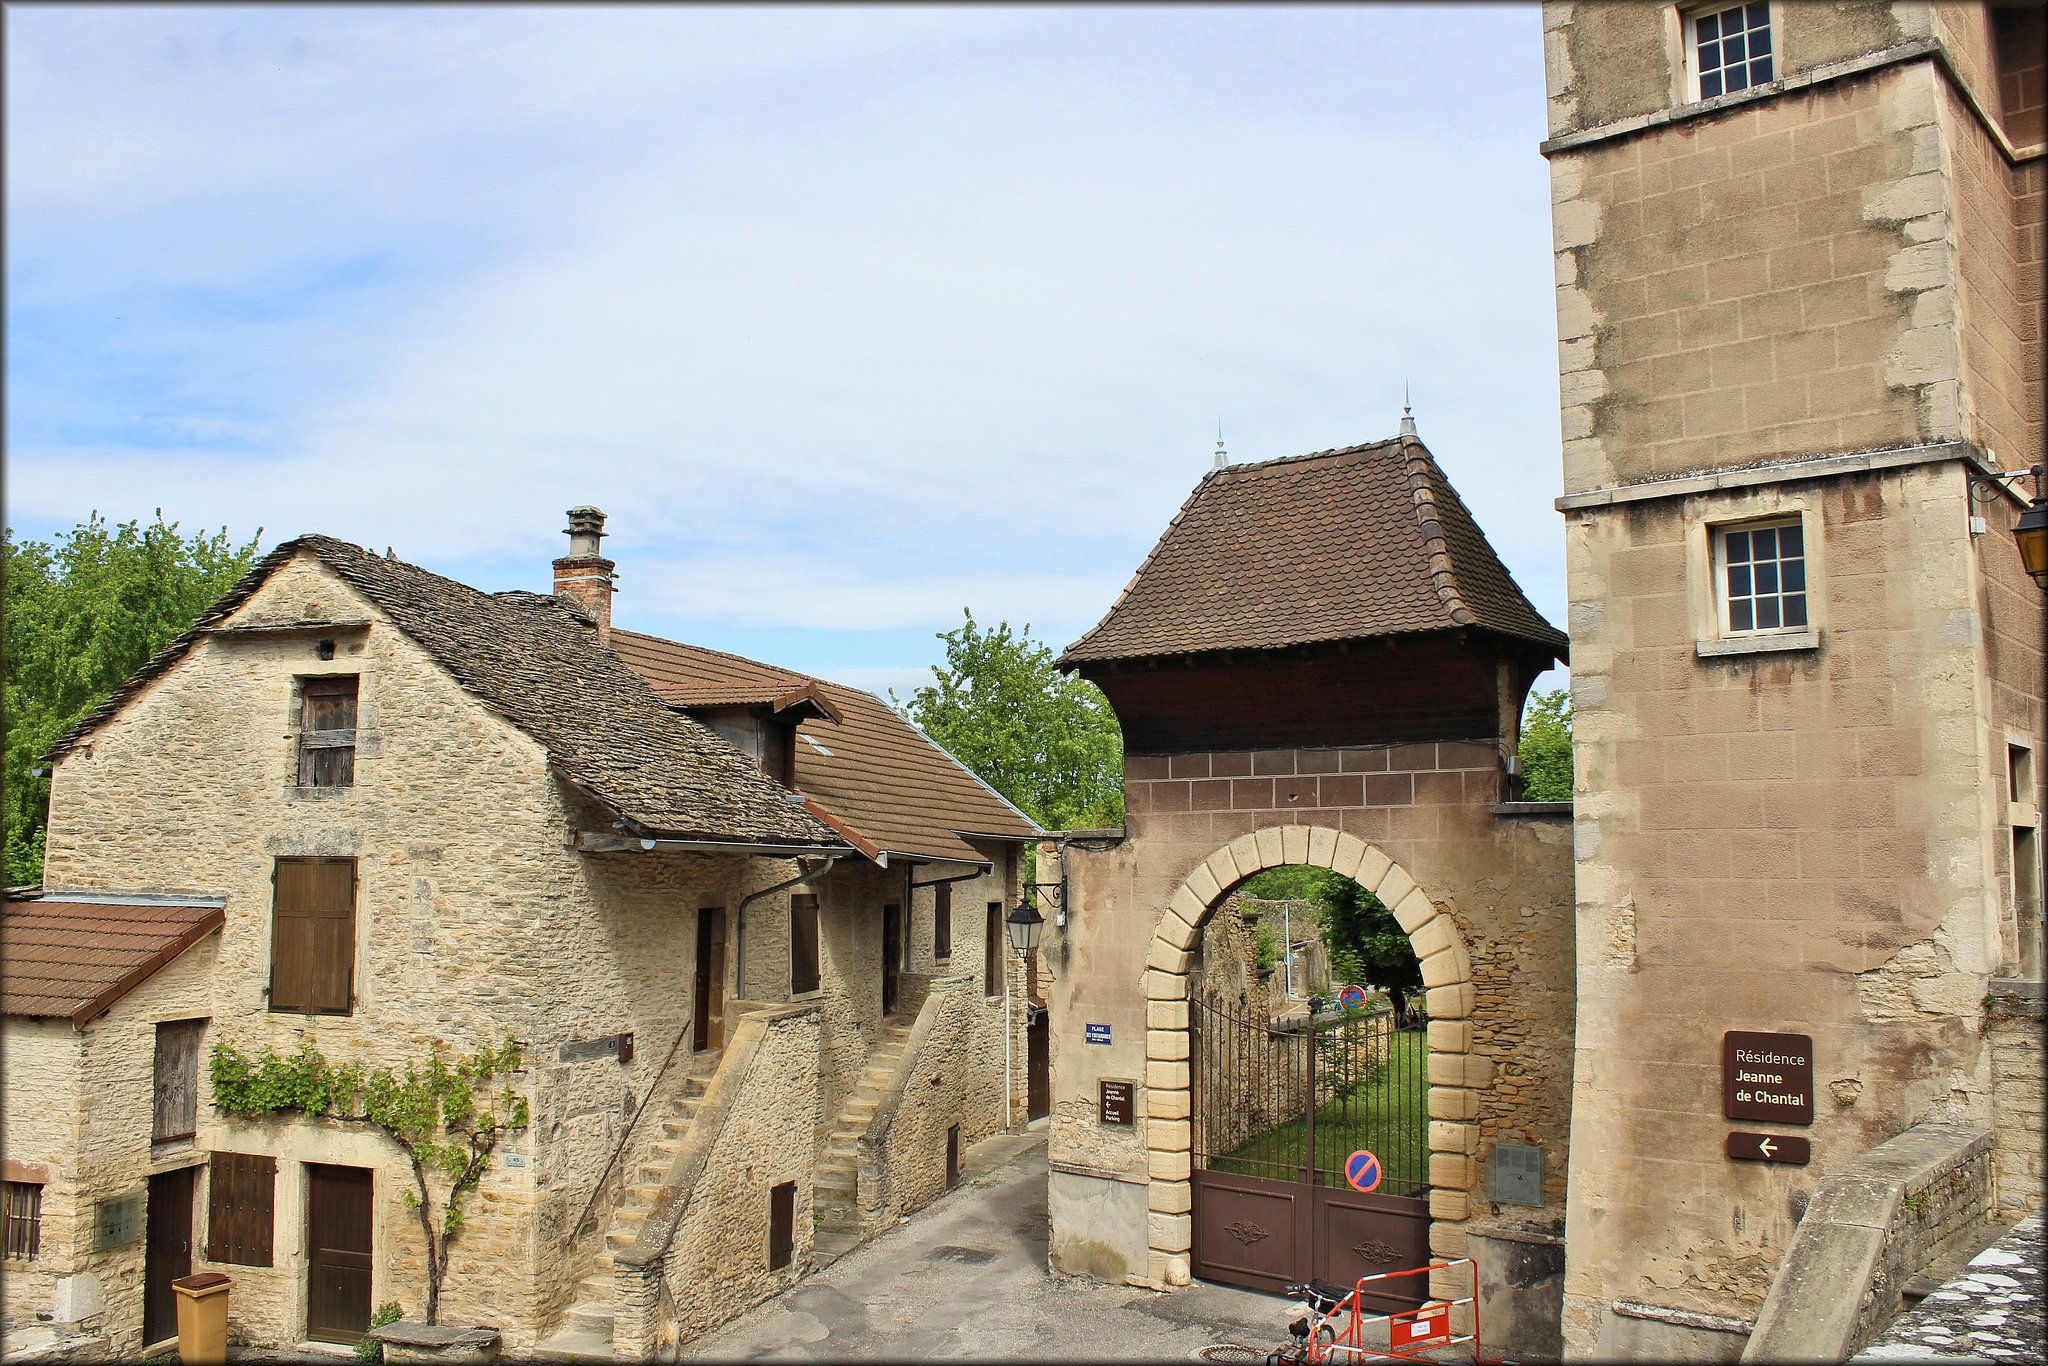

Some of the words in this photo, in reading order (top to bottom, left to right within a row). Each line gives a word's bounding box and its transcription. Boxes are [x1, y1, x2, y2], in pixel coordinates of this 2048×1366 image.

[1736, 1049, 1805, 1066] Résidence
[1735, 1069, 1783, 1084] Jeanne
[1736, 1089, 1752, 1102] de
[1755, 1090, 1805, 1106] Chantal
[1105, 1115, 1121, 1123] Parking
